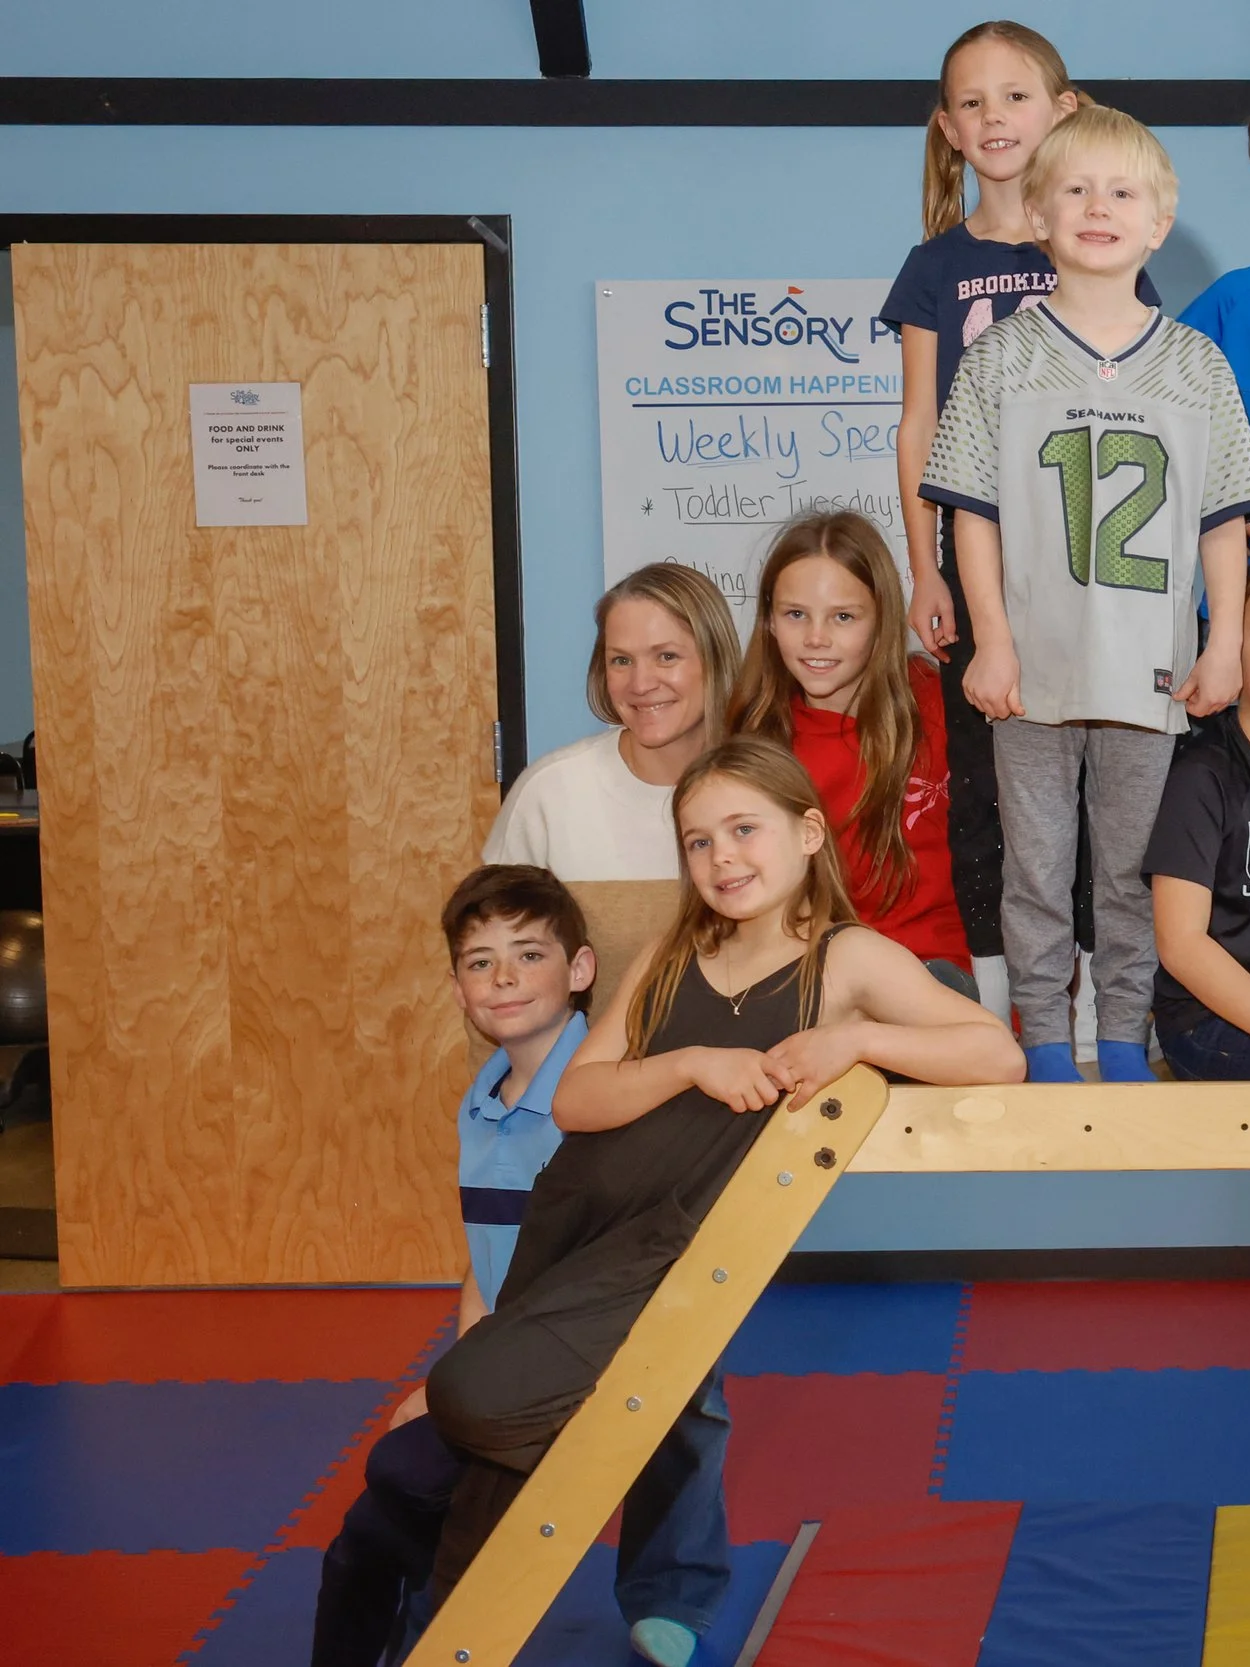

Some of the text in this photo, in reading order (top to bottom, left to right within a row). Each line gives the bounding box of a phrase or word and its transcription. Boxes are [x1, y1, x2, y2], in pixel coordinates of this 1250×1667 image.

[957, 272, 1058, 300] BROOKLY
[699, 289, 757, 315] THE
[664, 301, 859, 363] SENSORY
[625, 375, 903, 396] CLASSROOM HAPPENI
[1101, 368, 1115, 377] NFL
[208, 425, 234, 433] FOOD
[257, 424, 285, 432] DRINK
[1066, 408, 1145, 423] SEAHAWKS
[226, 435, 254, 445] special
[657, 414, 800, 479] Weekly
[662, 483, 775, 521] Toddler
[1038, 425, 1169, 594] 12
